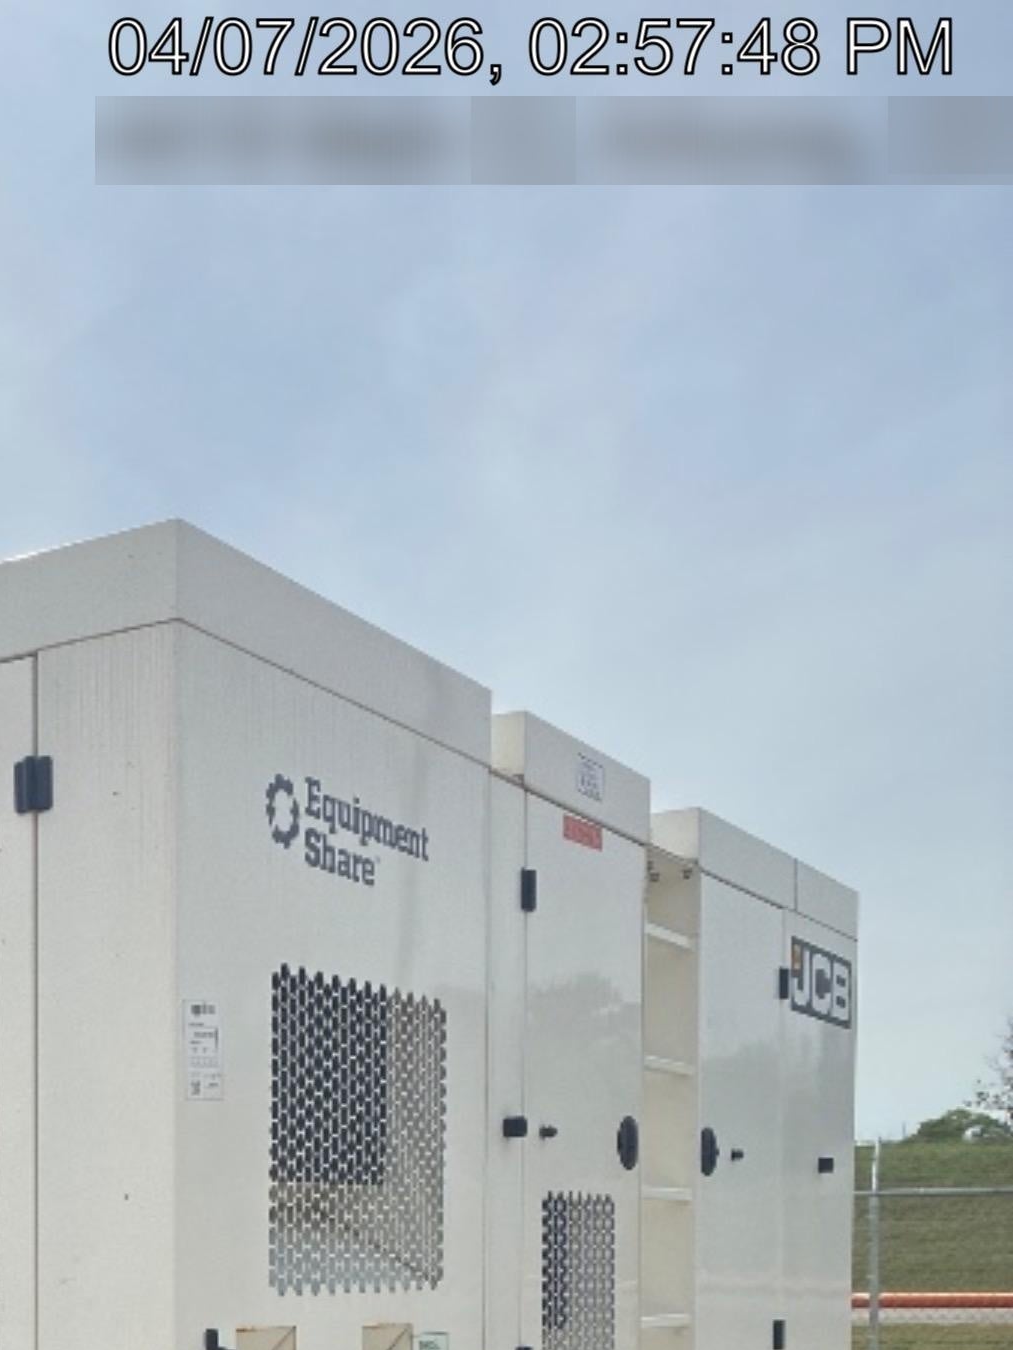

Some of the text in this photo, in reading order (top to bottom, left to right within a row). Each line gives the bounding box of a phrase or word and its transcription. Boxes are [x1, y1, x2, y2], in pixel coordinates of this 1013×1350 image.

[304, 776, 429, 862] Equipment
[304, 827, 376, 887] Share
[791, 941, 851, 1024] JCB
